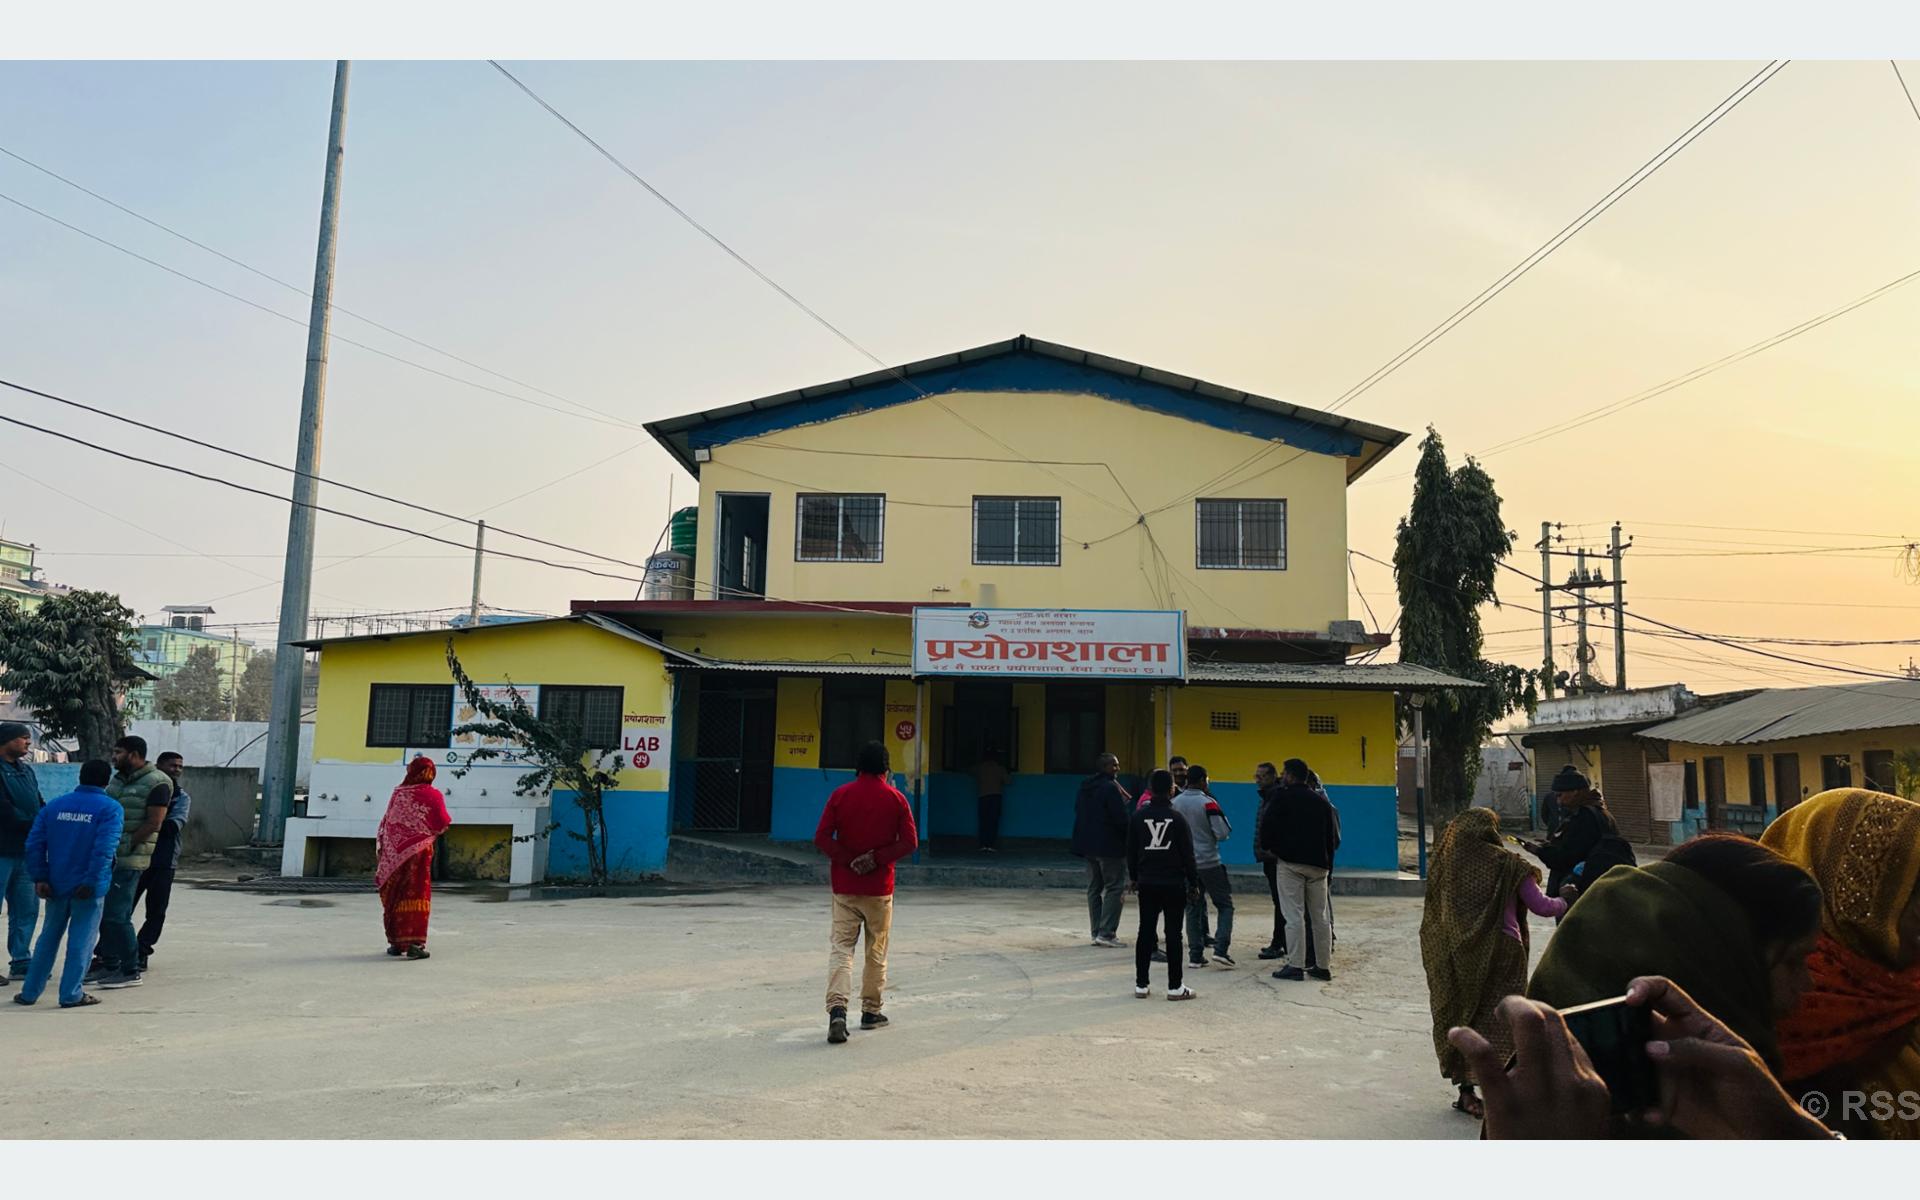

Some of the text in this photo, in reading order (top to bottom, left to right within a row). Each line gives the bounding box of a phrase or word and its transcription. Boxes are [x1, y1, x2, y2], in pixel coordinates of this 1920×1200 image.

[924, 634, 1171, 663] प्रयोगशाला
[624, 710, 666, 725] प्रयोगशाला
[624, 736, 660, 751] LAB
[56, 811, 93, 823] AMBULANCE
